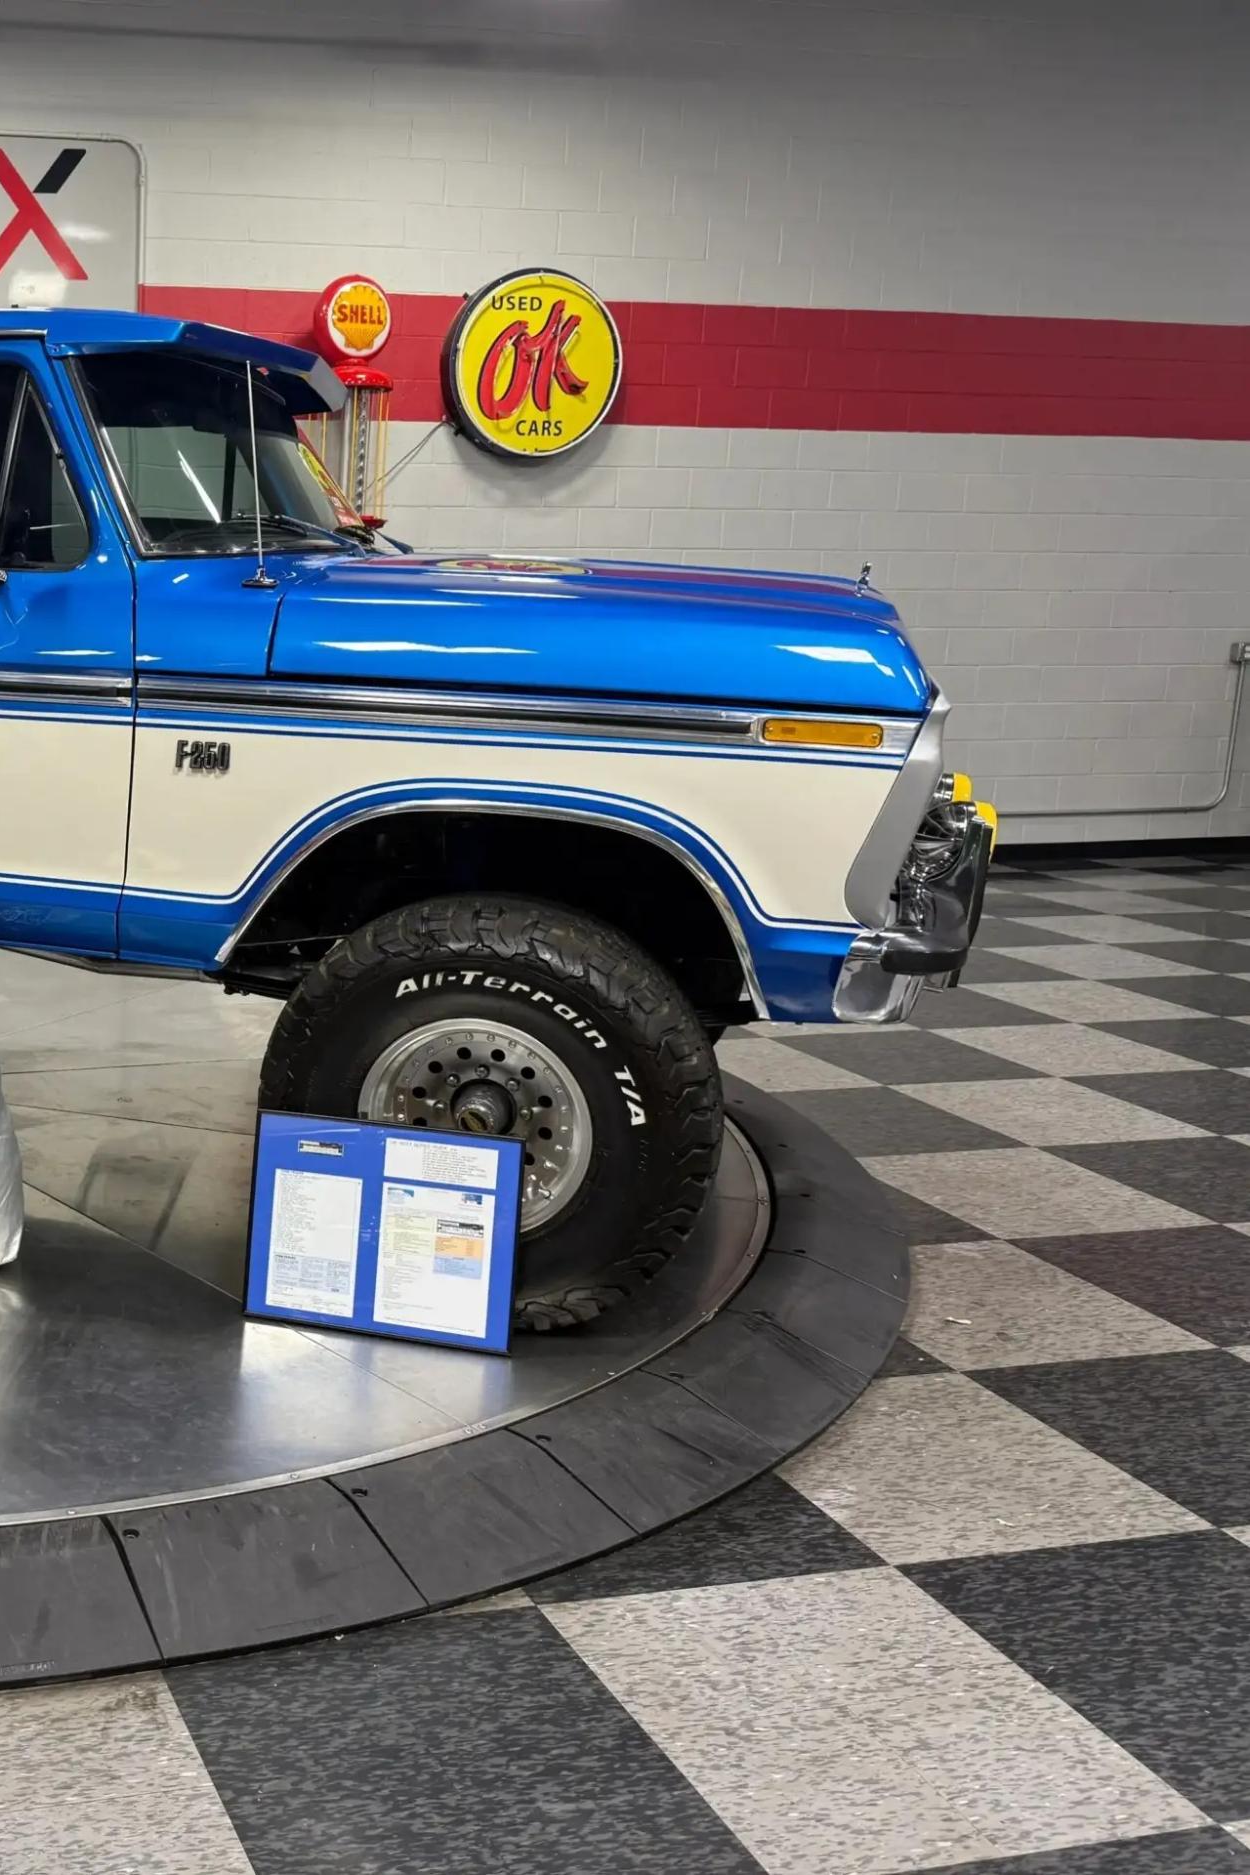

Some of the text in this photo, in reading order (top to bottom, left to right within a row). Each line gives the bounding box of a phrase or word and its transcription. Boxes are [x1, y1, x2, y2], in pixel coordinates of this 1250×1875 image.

[336, 303, 384, 325] SHELL
[491, 295, 543, 311] USED
[477, 299, 589, 421] OK
[516, 420, 562, 436] CARS
[394, 970, 647, 1126] All-Terrain T/A
